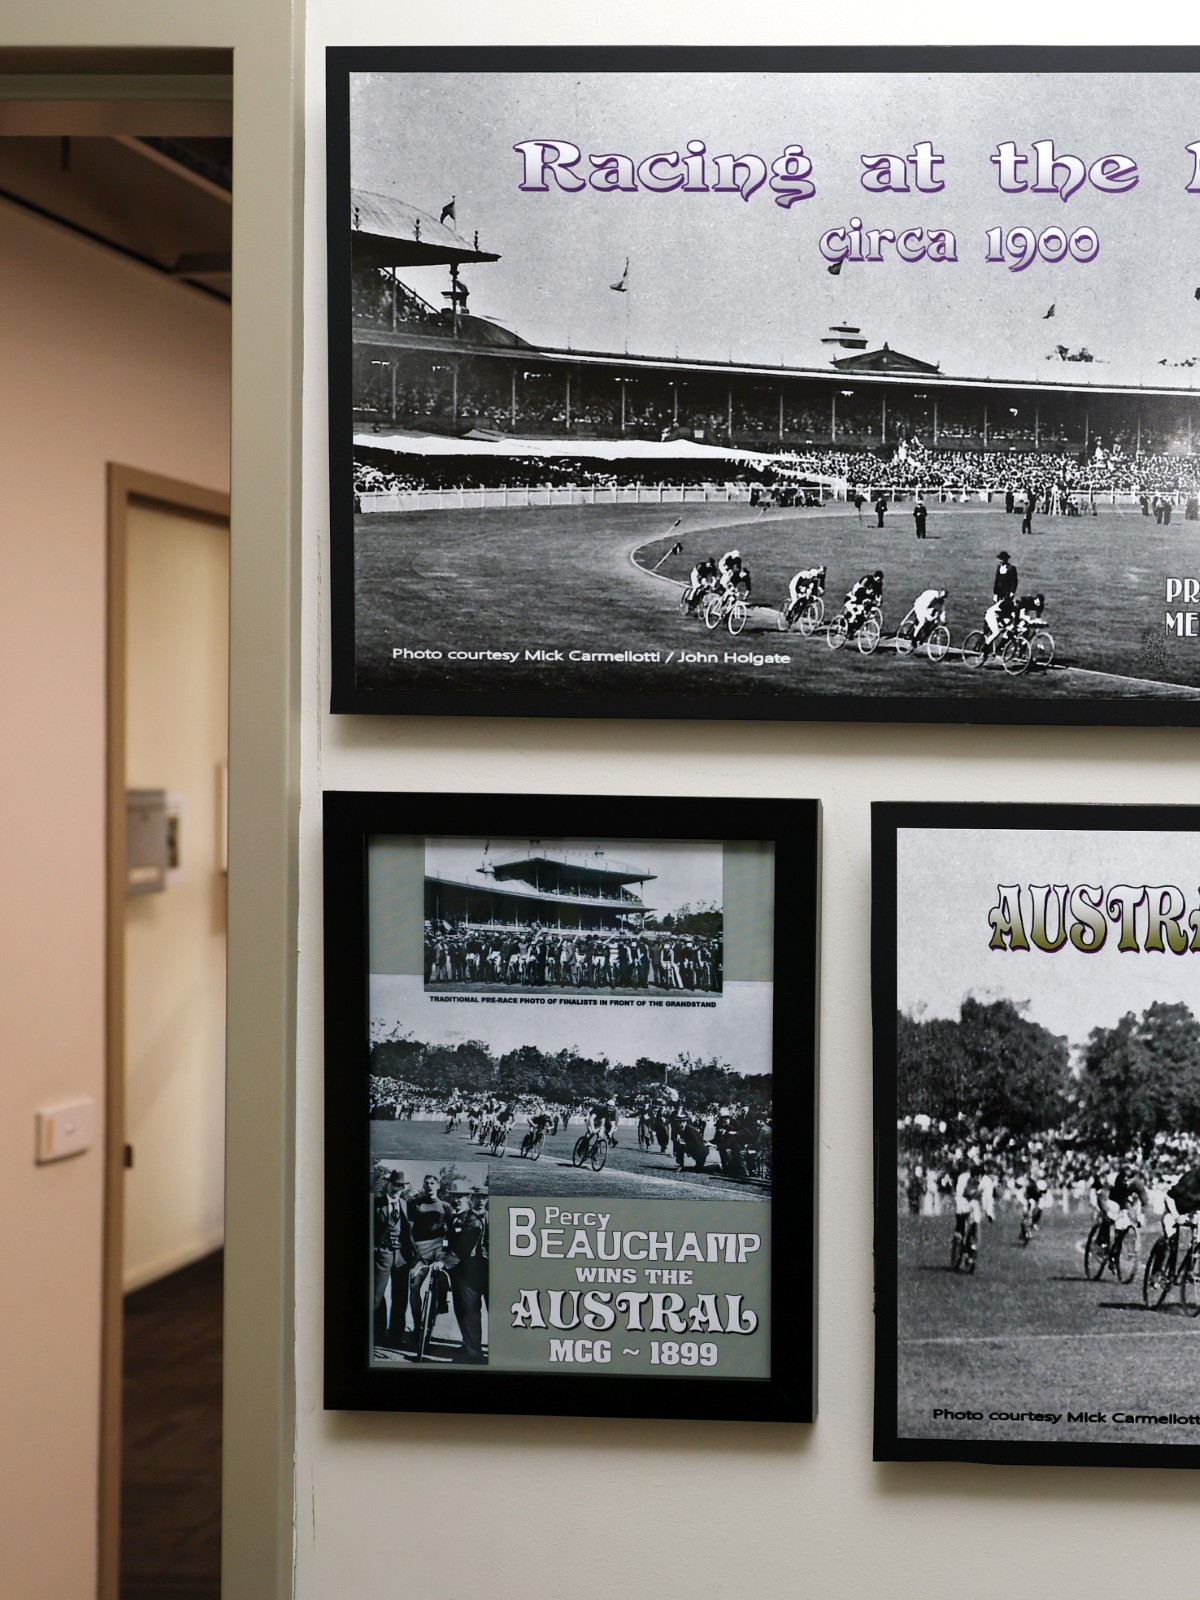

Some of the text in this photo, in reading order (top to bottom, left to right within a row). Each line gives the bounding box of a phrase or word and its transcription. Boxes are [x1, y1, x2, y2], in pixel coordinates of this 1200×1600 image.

[513, 139, 816, 209] Racing
[860, 141, 945, 193] at
[990, 140, 1140, 202] the
[819, 217, 1100, 272] circa 1900
[392, 648, 442, 661] Photo
[447, 649, 520, 663] courtesy
[524, 650, 564, 661] Mick
[568, 650, 661, 663] Carmellotti
[676, 652, 719, 663] John
[724, 652, 791, 666] Holgate
[429, 995, 480, 1003] TRADITIONAL
[481, 996, 518, 1004] PRE-RACE
[544, 1205, 611, 1231] Percy
[508, 1206, 761, 1264] BEAUCHAMP
[575, 1267, 694, 1286] WINS THE
[510, 1288, 759, 1335] AUSTRAL
[549, 1339, 612, 1363] MCG
[649, 1341, 719, 1367] 1899
[932, 1408, 984, 1421] Photo
[988, 1410, 1062, 1424] courtesy
[1067, 1411, 1107, 1424] Mick
